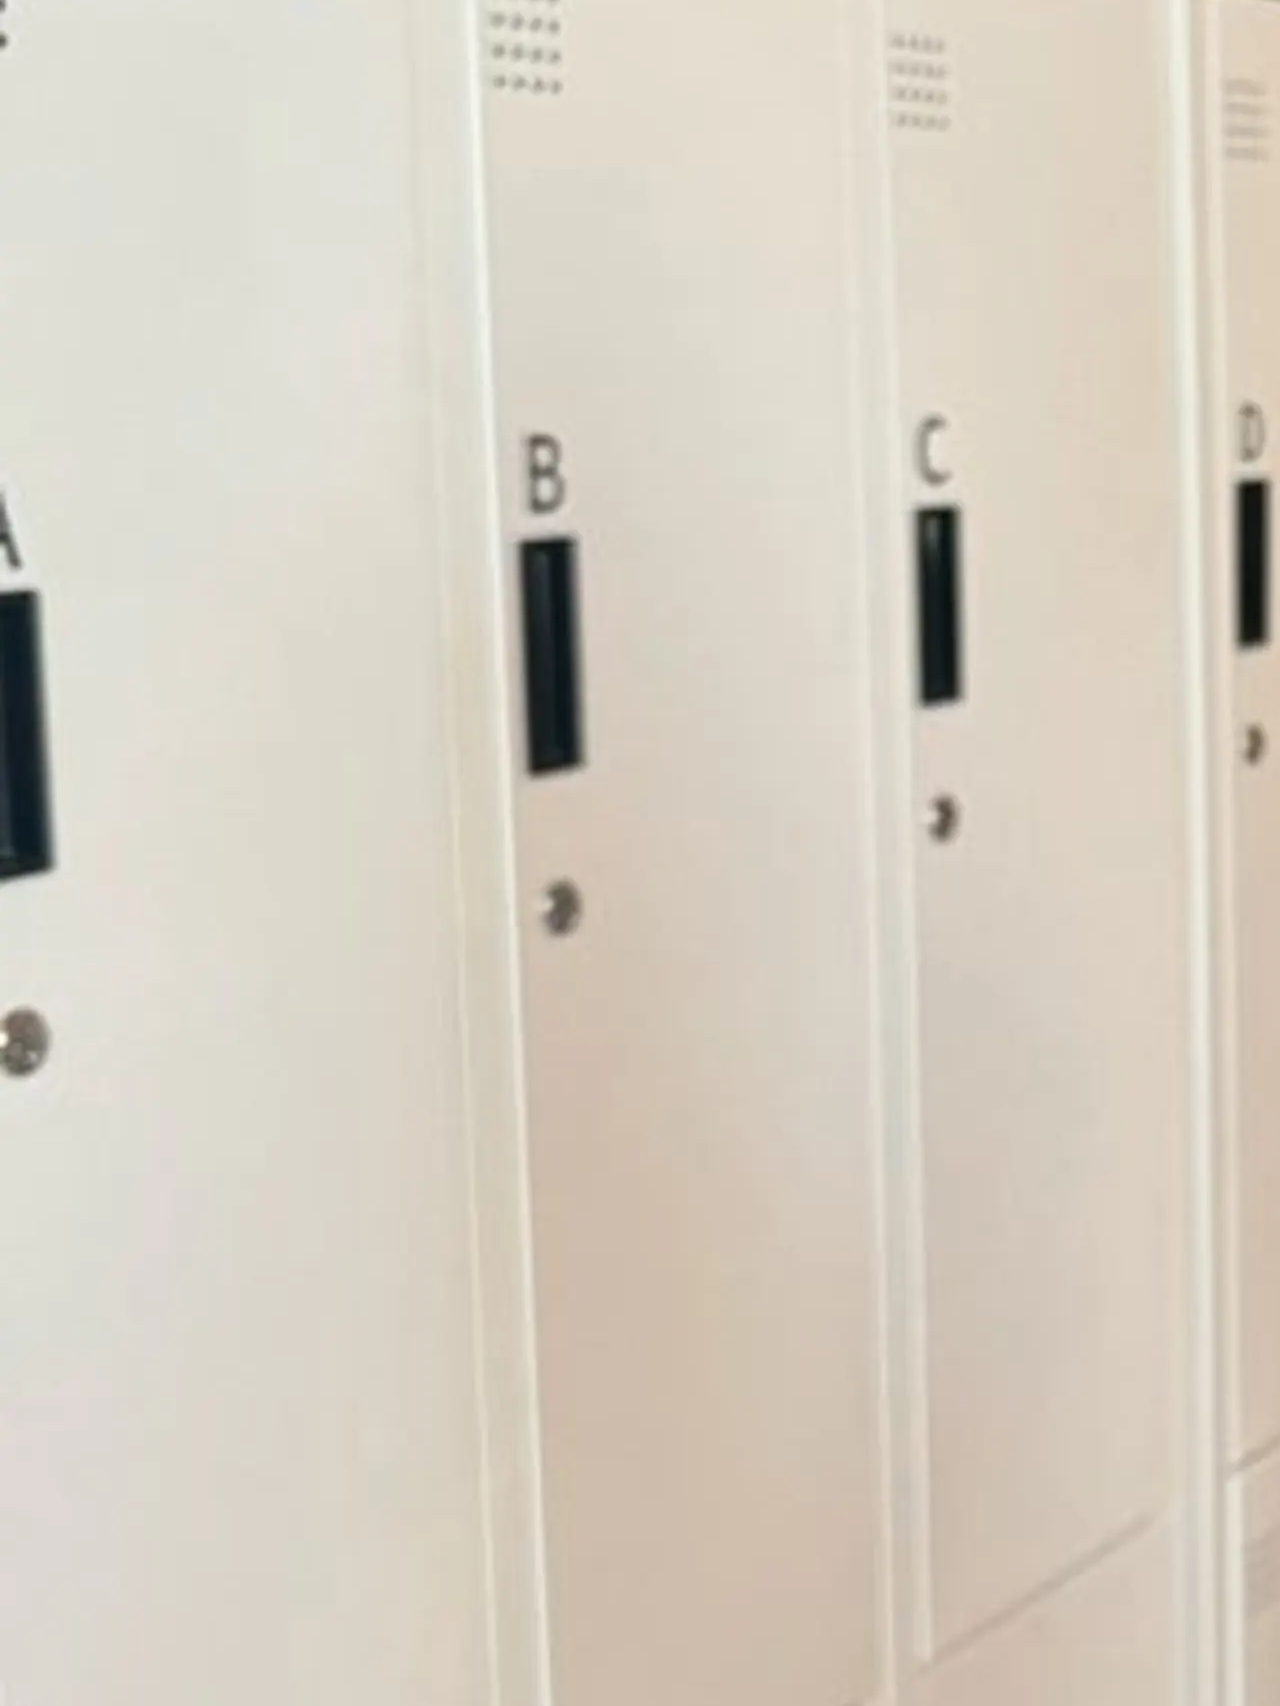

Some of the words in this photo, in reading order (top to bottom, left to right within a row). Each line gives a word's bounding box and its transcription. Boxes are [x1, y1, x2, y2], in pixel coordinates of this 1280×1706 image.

[913, 412, 954, 489] C
[1237, 399, 1266, 463] D
[526, 432, 566, 514] B
